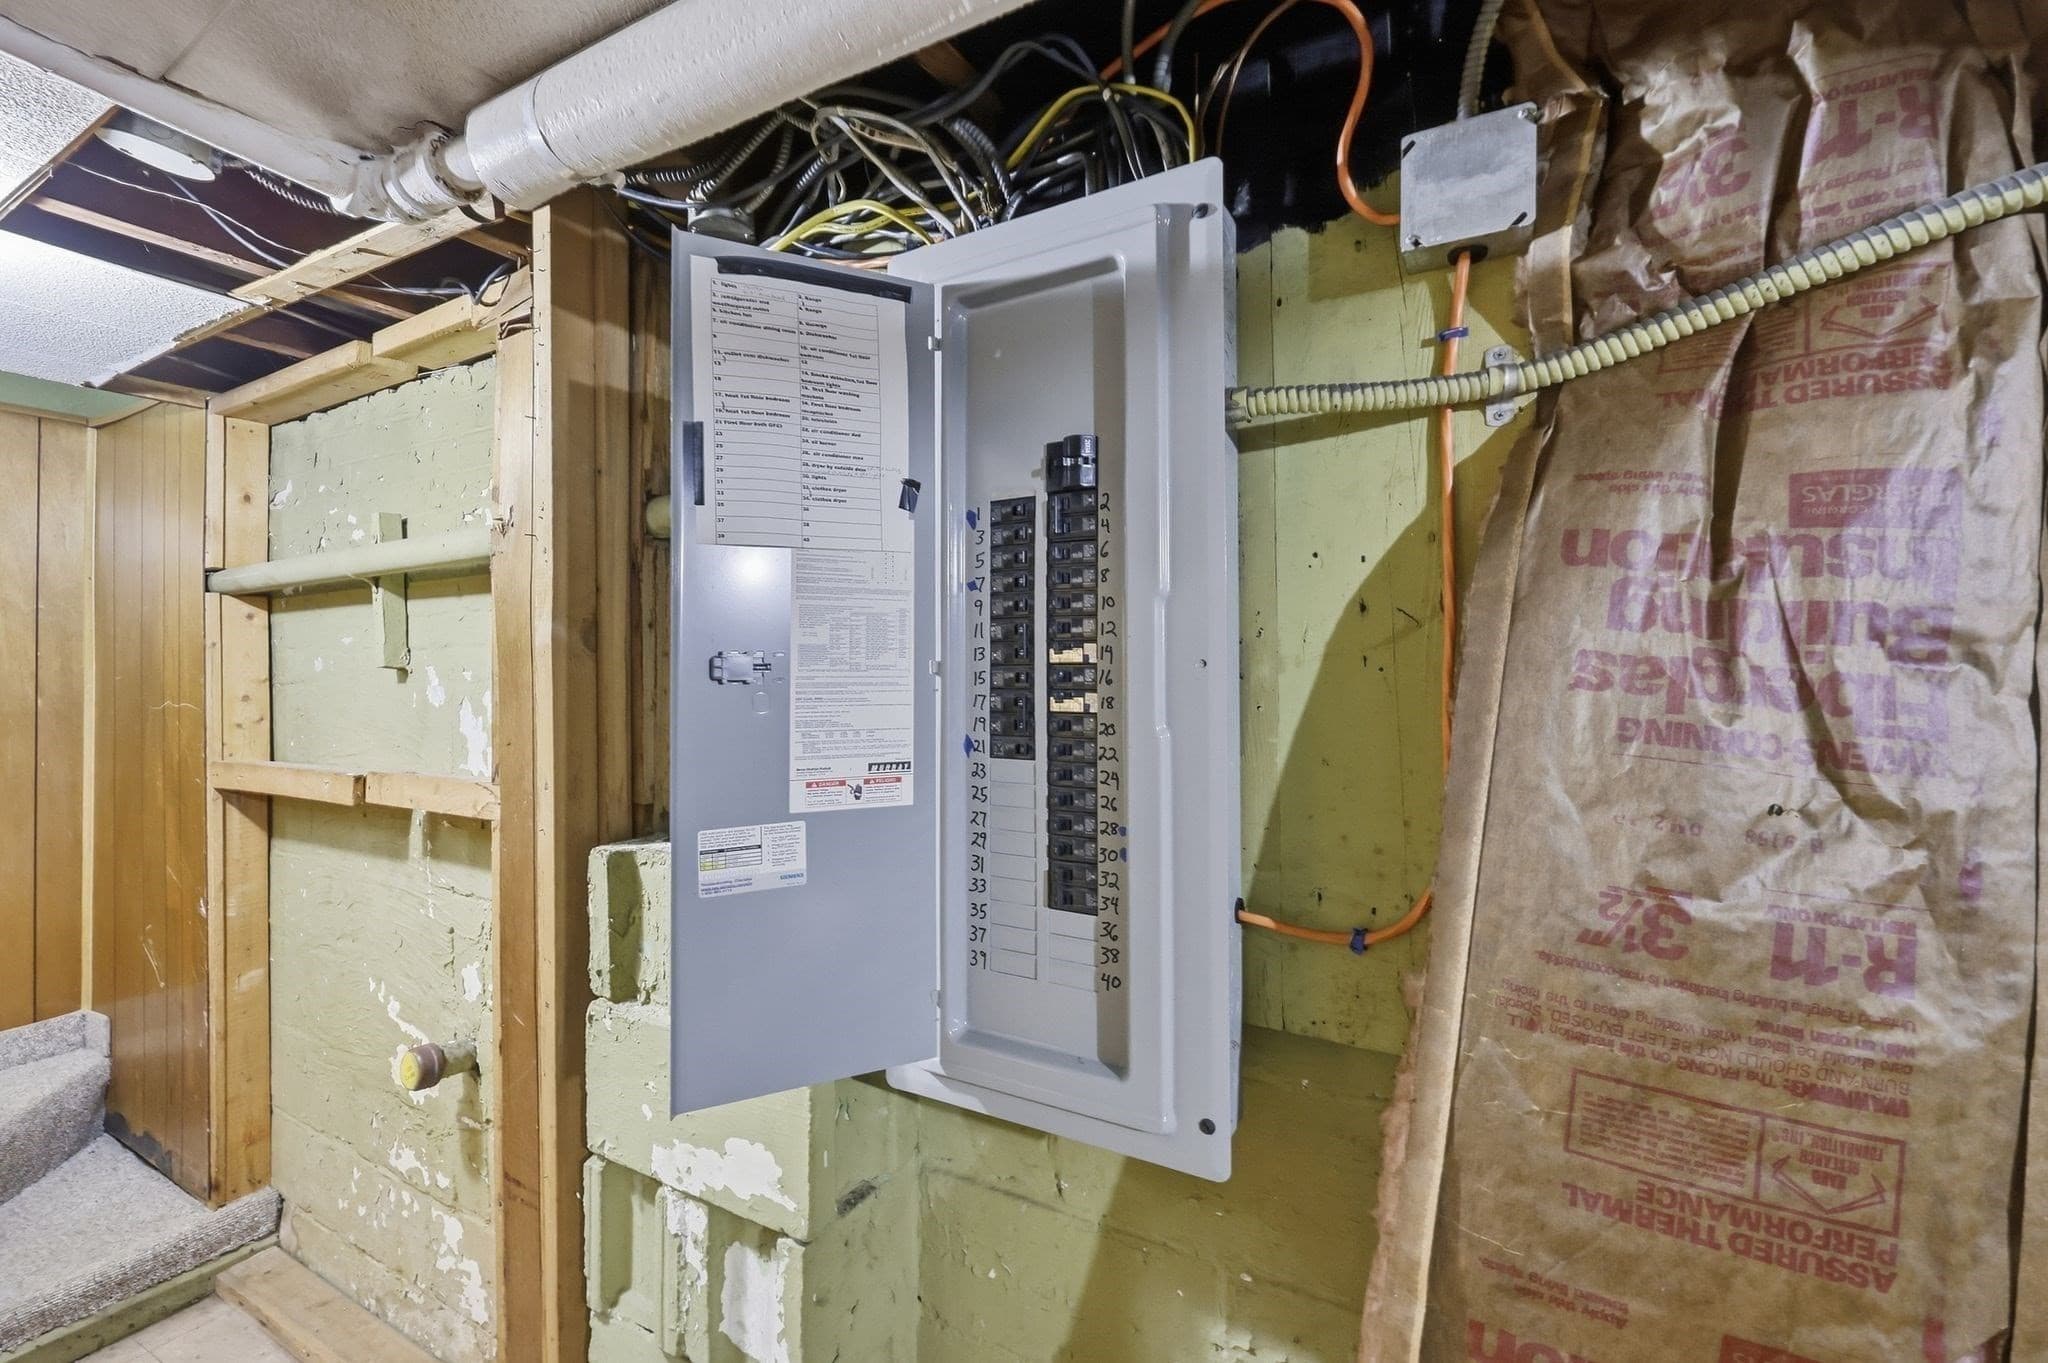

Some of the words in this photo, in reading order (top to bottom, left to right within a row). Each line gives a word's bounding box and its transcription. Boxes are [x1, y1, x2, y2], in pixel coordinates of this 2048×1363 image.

[1751, 345, 1950, 391] PERFORMA
[1782, 367, 1952, 405] ASSURED
[1100, 492, 1111, 514] 2
[976, 507, 981, 521] 1
[1100, 518, 1110, 534] 4
[975, 530, 985, 545] 3
[1100, 541, 1109, 558] 6
[975, 552, 985, 569] 5
[1100, 568, 1110, 582] 8
[975, 577, 985, 592] 7
[974, 600, 983, 616] 9
[1101, 596, 1115, 608] 10
[1100, 621, 1117, 637] 12
[1606, 575, 1954, 669] Building
[974, 626, 984, 639] 11
[973, 647, 985, 662] 13
[1100, 645, 1113, 664] 14
[973, 671, 986, 686] 15
[1099, 669, 1113, 685] 16
[973, 694, 987, 710] 17
[1100, 696, 1115, 709] 18
[1567, 648, 1950, 744] Fiberglas
[973, 717, 986, 732] 19
[1099, 723, 1116, 737] 20
[973, 739, 985, 753] 21
[1098, 747, 1119, 762] 22
[971, 762, 987, 779] 23
[1100, 770, 1120, 790] 24
[971, 785, 988, 803] 25
[1100, 796, 1118, 812] 26
[970, 811, 987, 828] 27
[1099, 822, 1119, 836] 28
[970, 832, 987, 850] 29
[970, 855, 984, 873] 31
[1099, 847, 1118, 864] 30
[969, 878, 987, 893] 33
[1099, 871, 1120, 890] 32
[970, 902, 988, 919] 35
[1099, 896, 1119, 915] 34
[1766, 904, 1810, 928] ONLY
[1814, 910, 1917, 937] INSULATION
[969, 925, 987, 943] 37
[1099, 922, 1119, 941] 36
[969, 950, 987, 969] 39
[1099, 947, 1120, 965] 38
[1769, 921, 1918, 1002] R-11
[1101, 973, 1122, 991] 40
[1648, 974, 1660, 988] is
[1494, 994, 1542, 1017] Special
[1545, 991, 1568, 1008] the
[1573, 998, 1588, 1013] to
[1732, 989, 1788, 1013] building
[1593, 1003, 1631, 1021] close
[1626, 1030, 1666, 1047] LEFT
[1701, 1026, 1742, 1043] when
[1810, 1031, 1851, 1048] open
[1620, 1042, 1646, 1060] this
[1669, 1037, 1691, 1054] BE
[1697, 1042, 1732, 1063] NOT
[1748, 1036, 1793, 1055] taken
[1855, 1038, 1877, 1052] an
[1882, 1043, 1916, 1060] with
[1650, 1049, 1671, 1064] on
[1798, 1046, 1817, 1063] be
[1822, 1051, 1875, 1072] should
[1676, 1056, 1740, 1082] FACING
[1737, 1051, 1811, 1079] SHOULD
[1880, 1059, 1913, 1076] care
[1746, 1070, 1777, 1089] The
[1816, 1067, 1857, 1087] AND
[1861, 1076, 1910, 1096] BURN
[1561, 1182, 1721, 1251] THERMAL
[1637, 1180, 1898, 1266] PERFORMANCE
[1727, 1232, 1897, 1294] ASSURED
